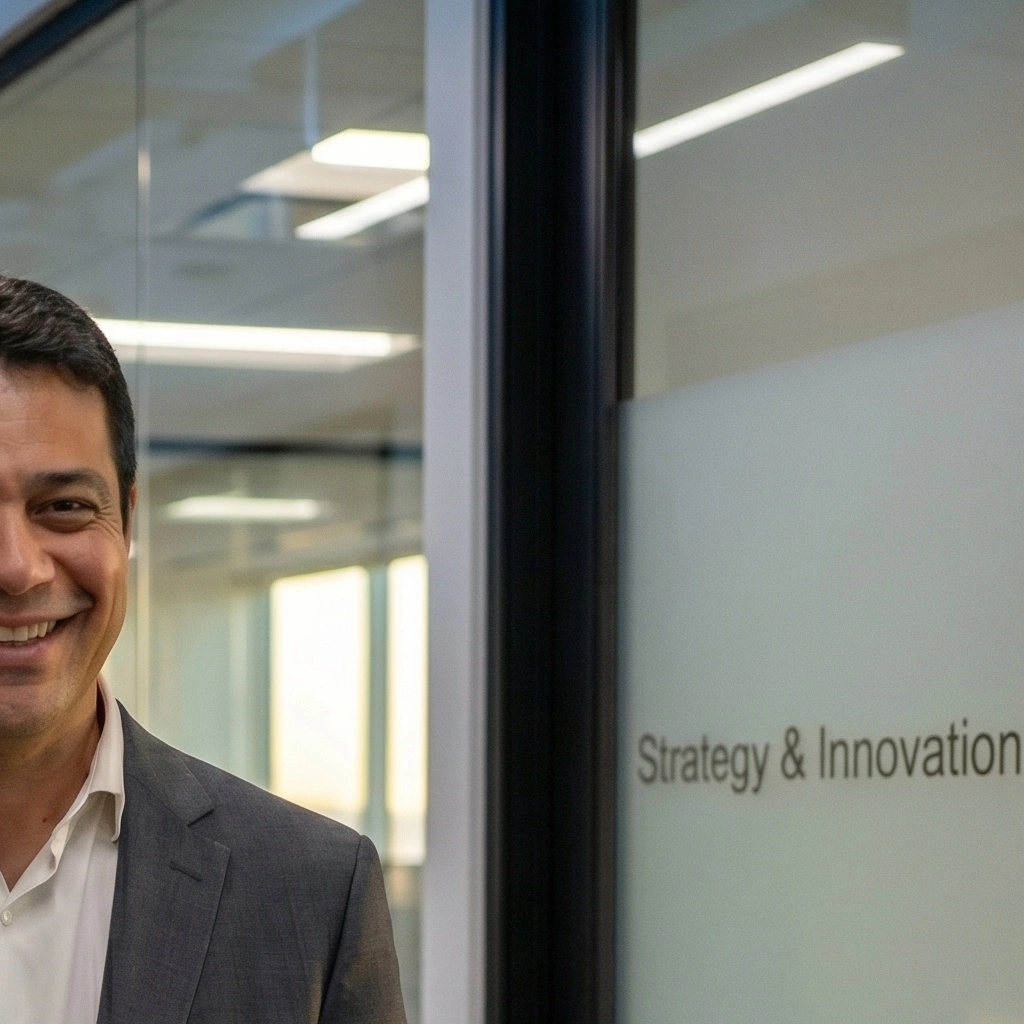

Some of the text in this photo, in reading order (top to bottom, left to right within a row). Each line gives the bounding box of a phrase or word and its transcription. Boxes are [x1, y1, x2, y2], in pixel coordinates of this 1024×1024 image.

[637, 718, 1022, 794] Strategy & Innovation
